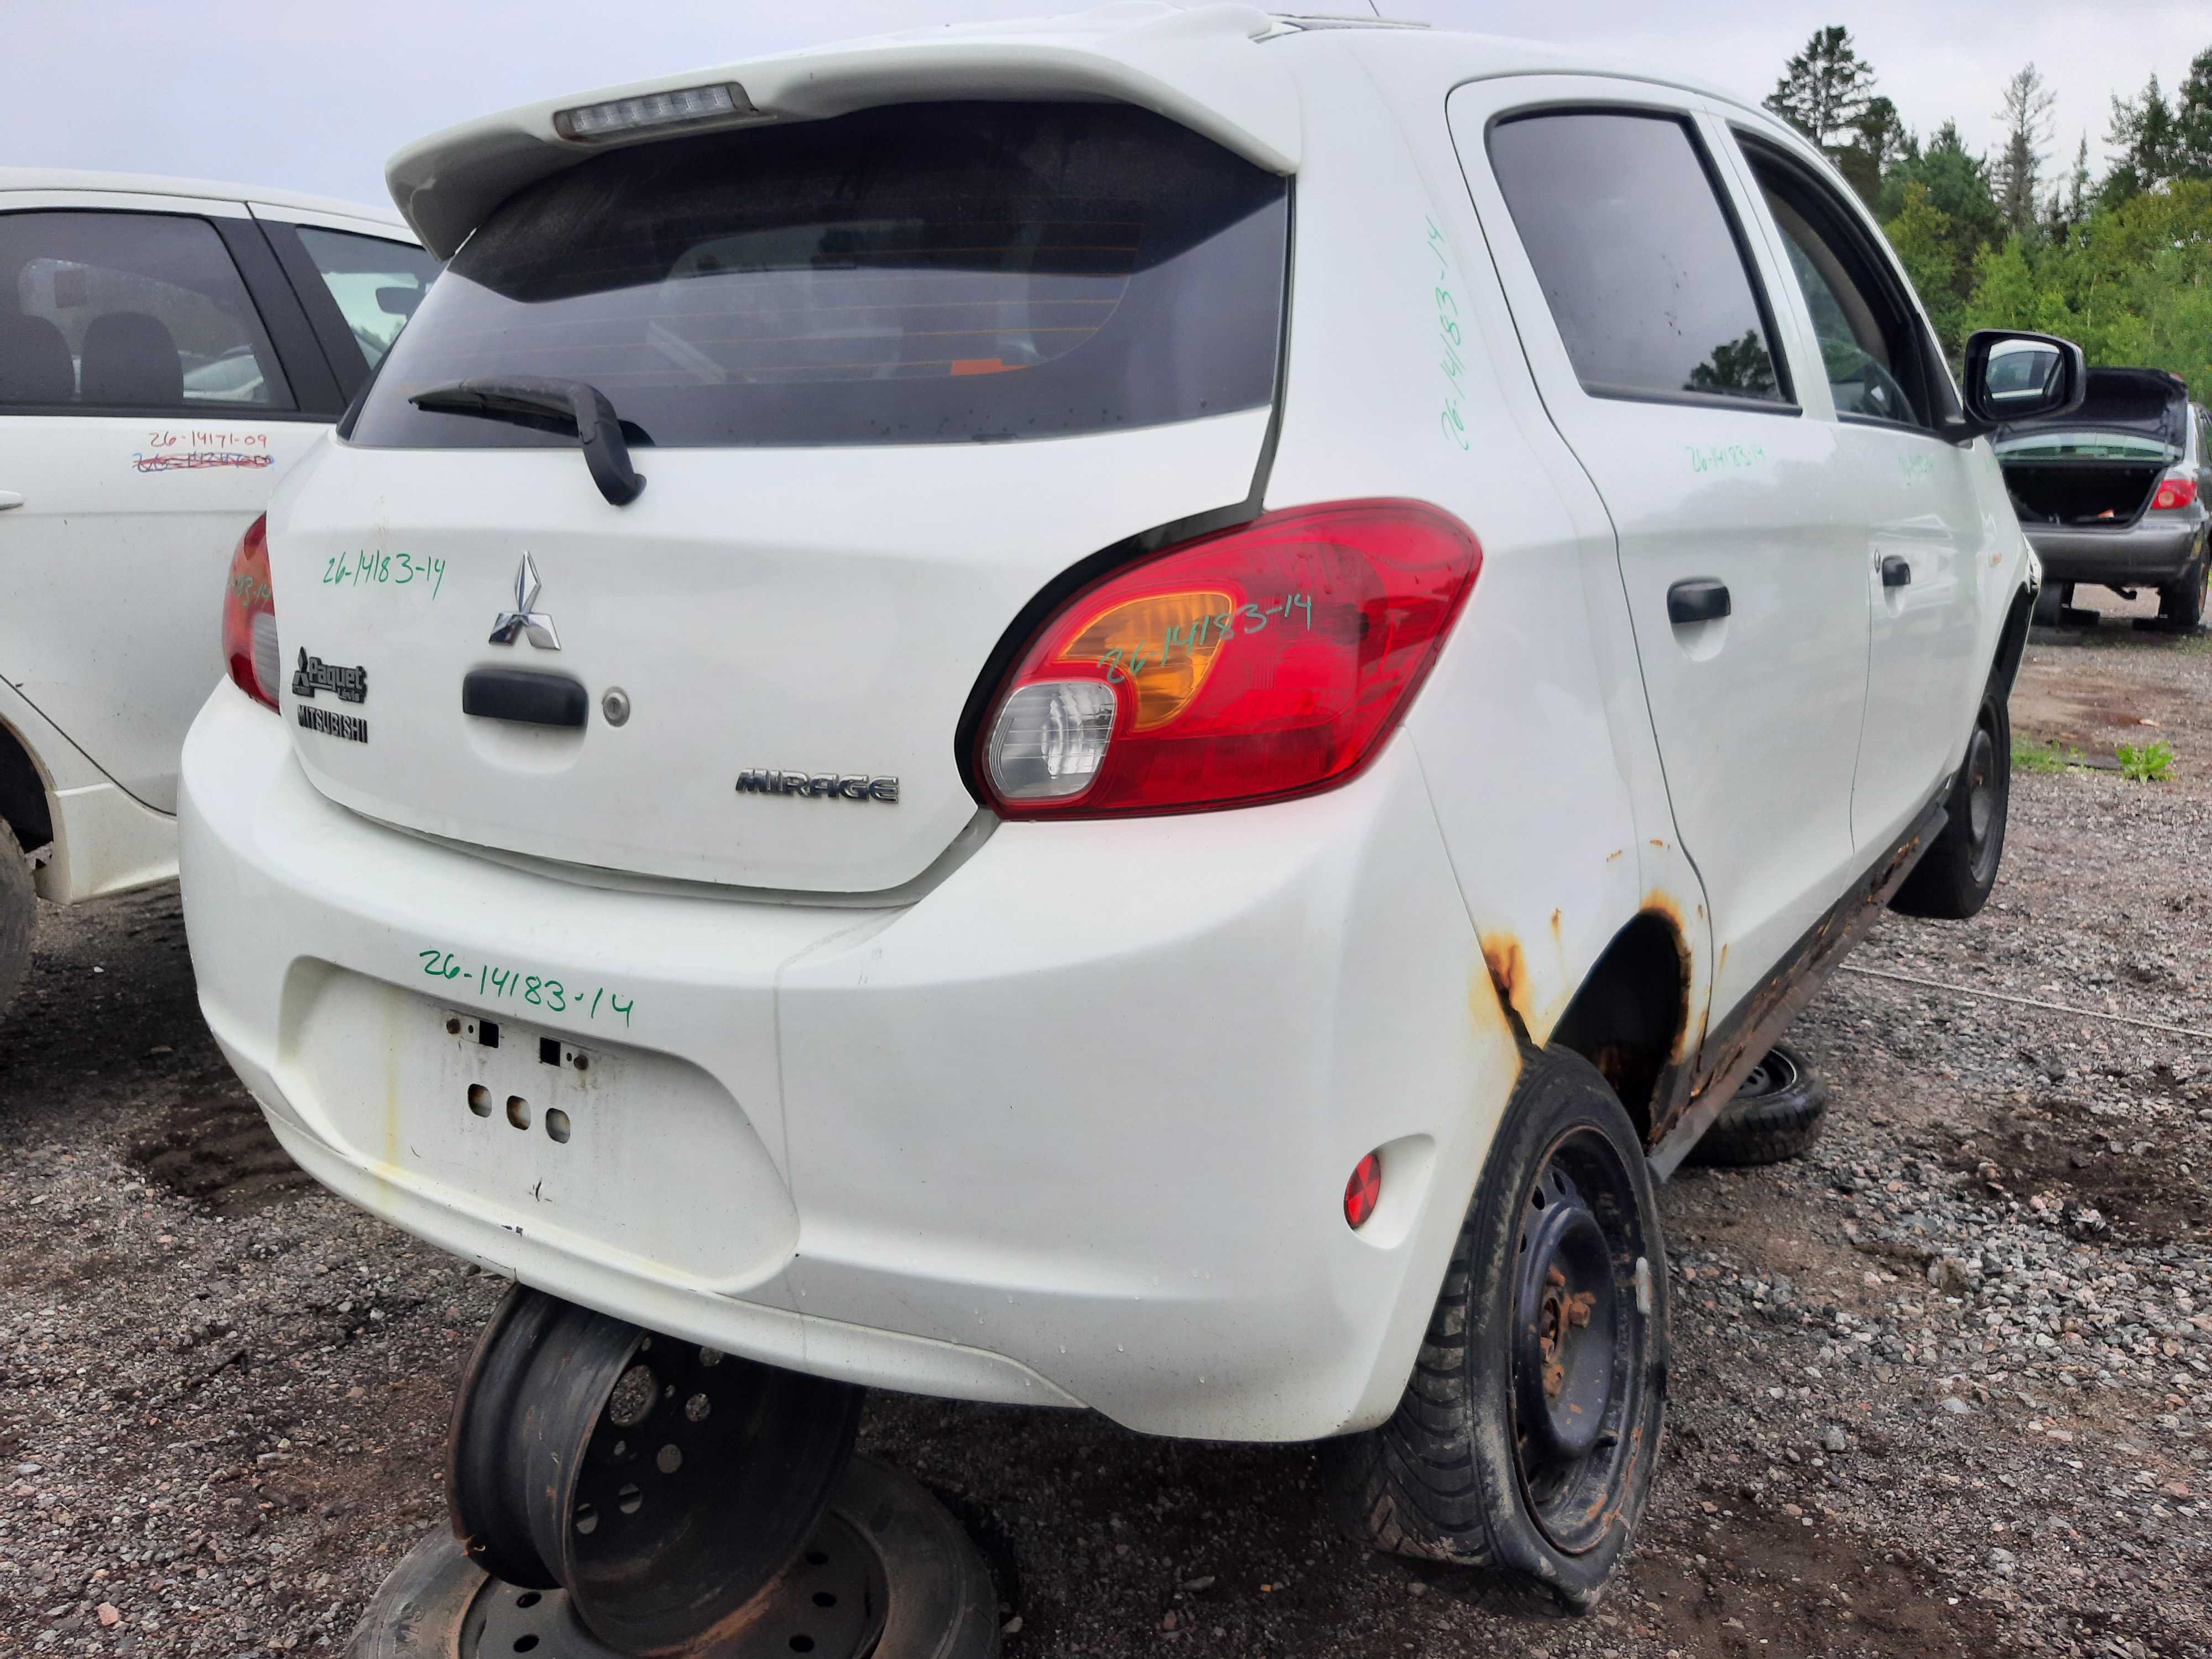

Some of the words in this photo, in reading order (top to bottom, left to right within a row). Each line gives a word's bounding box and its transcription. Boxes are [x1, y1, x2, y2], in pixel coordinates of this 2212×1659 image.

[1425, 213, 1469, 451] 26-14183-14
[149, 430, 267, 448] 26-14171-09
[322, 550, 445, 599] 26-14183-14
[1097, 593, 1313, 684] 26-14183-14
[309, 656, 365, 692] Paquet
[297, 704, 368, 744] MITSUBISHI
[735, 768, 899, 802] MIRAGE
[419, 950, 634, 1028] 26-14183-14
